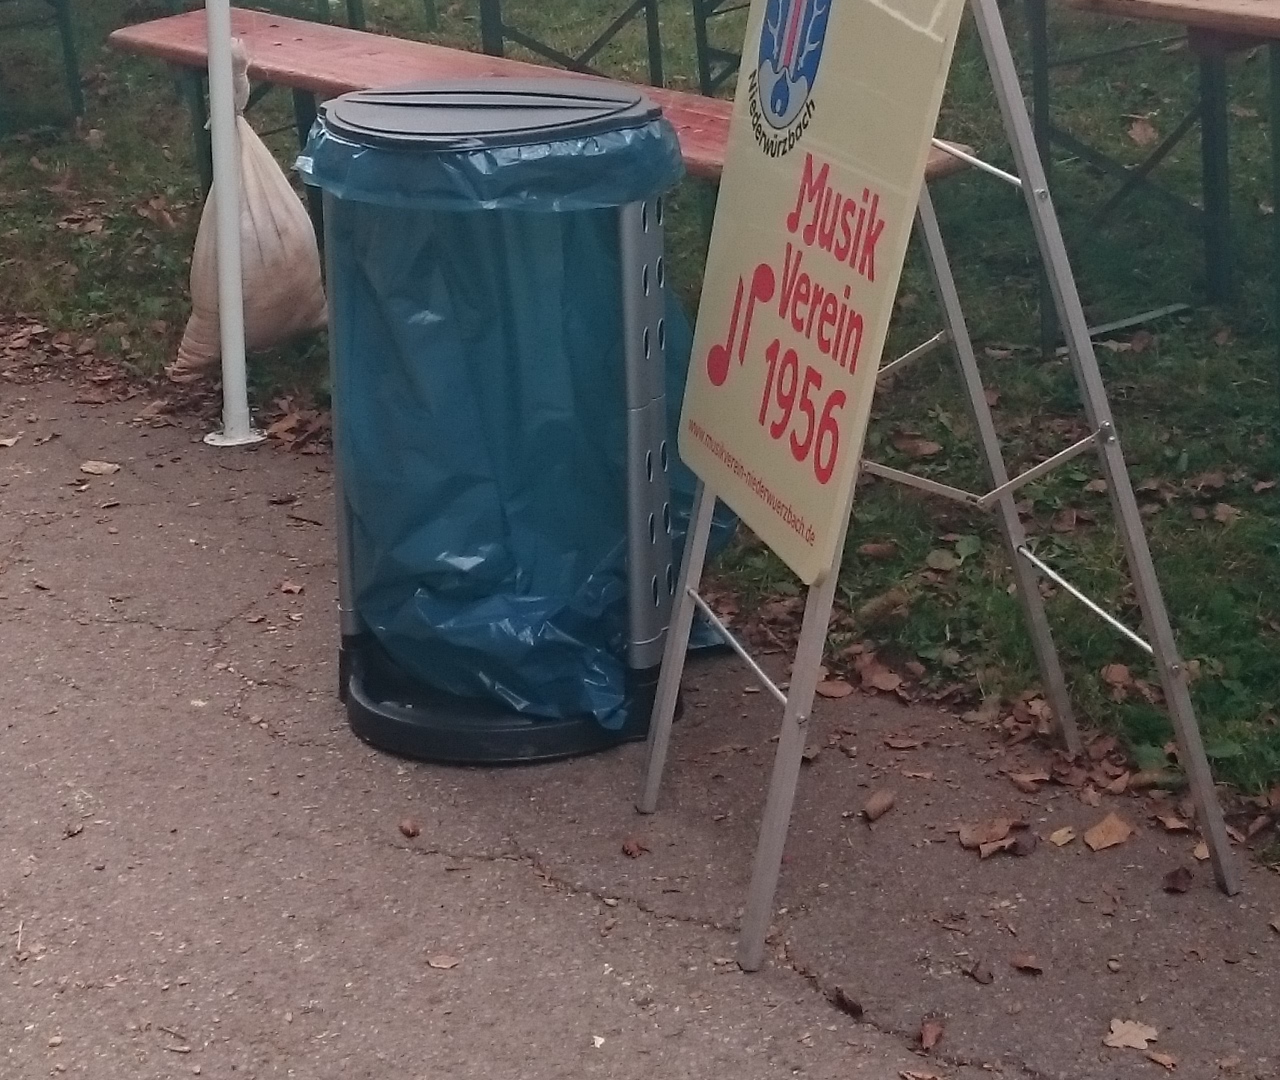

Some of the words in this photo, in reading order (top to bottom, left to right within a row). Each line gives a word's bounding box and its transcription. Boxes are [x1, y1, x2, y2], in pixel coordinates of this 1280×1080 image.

[748, 69, 816, 158] Niederwürzbach
[787, 152, 885, 282] Musik
[779, 242, 864, 375] Verein
[758, 338, 847, 484] 1956
